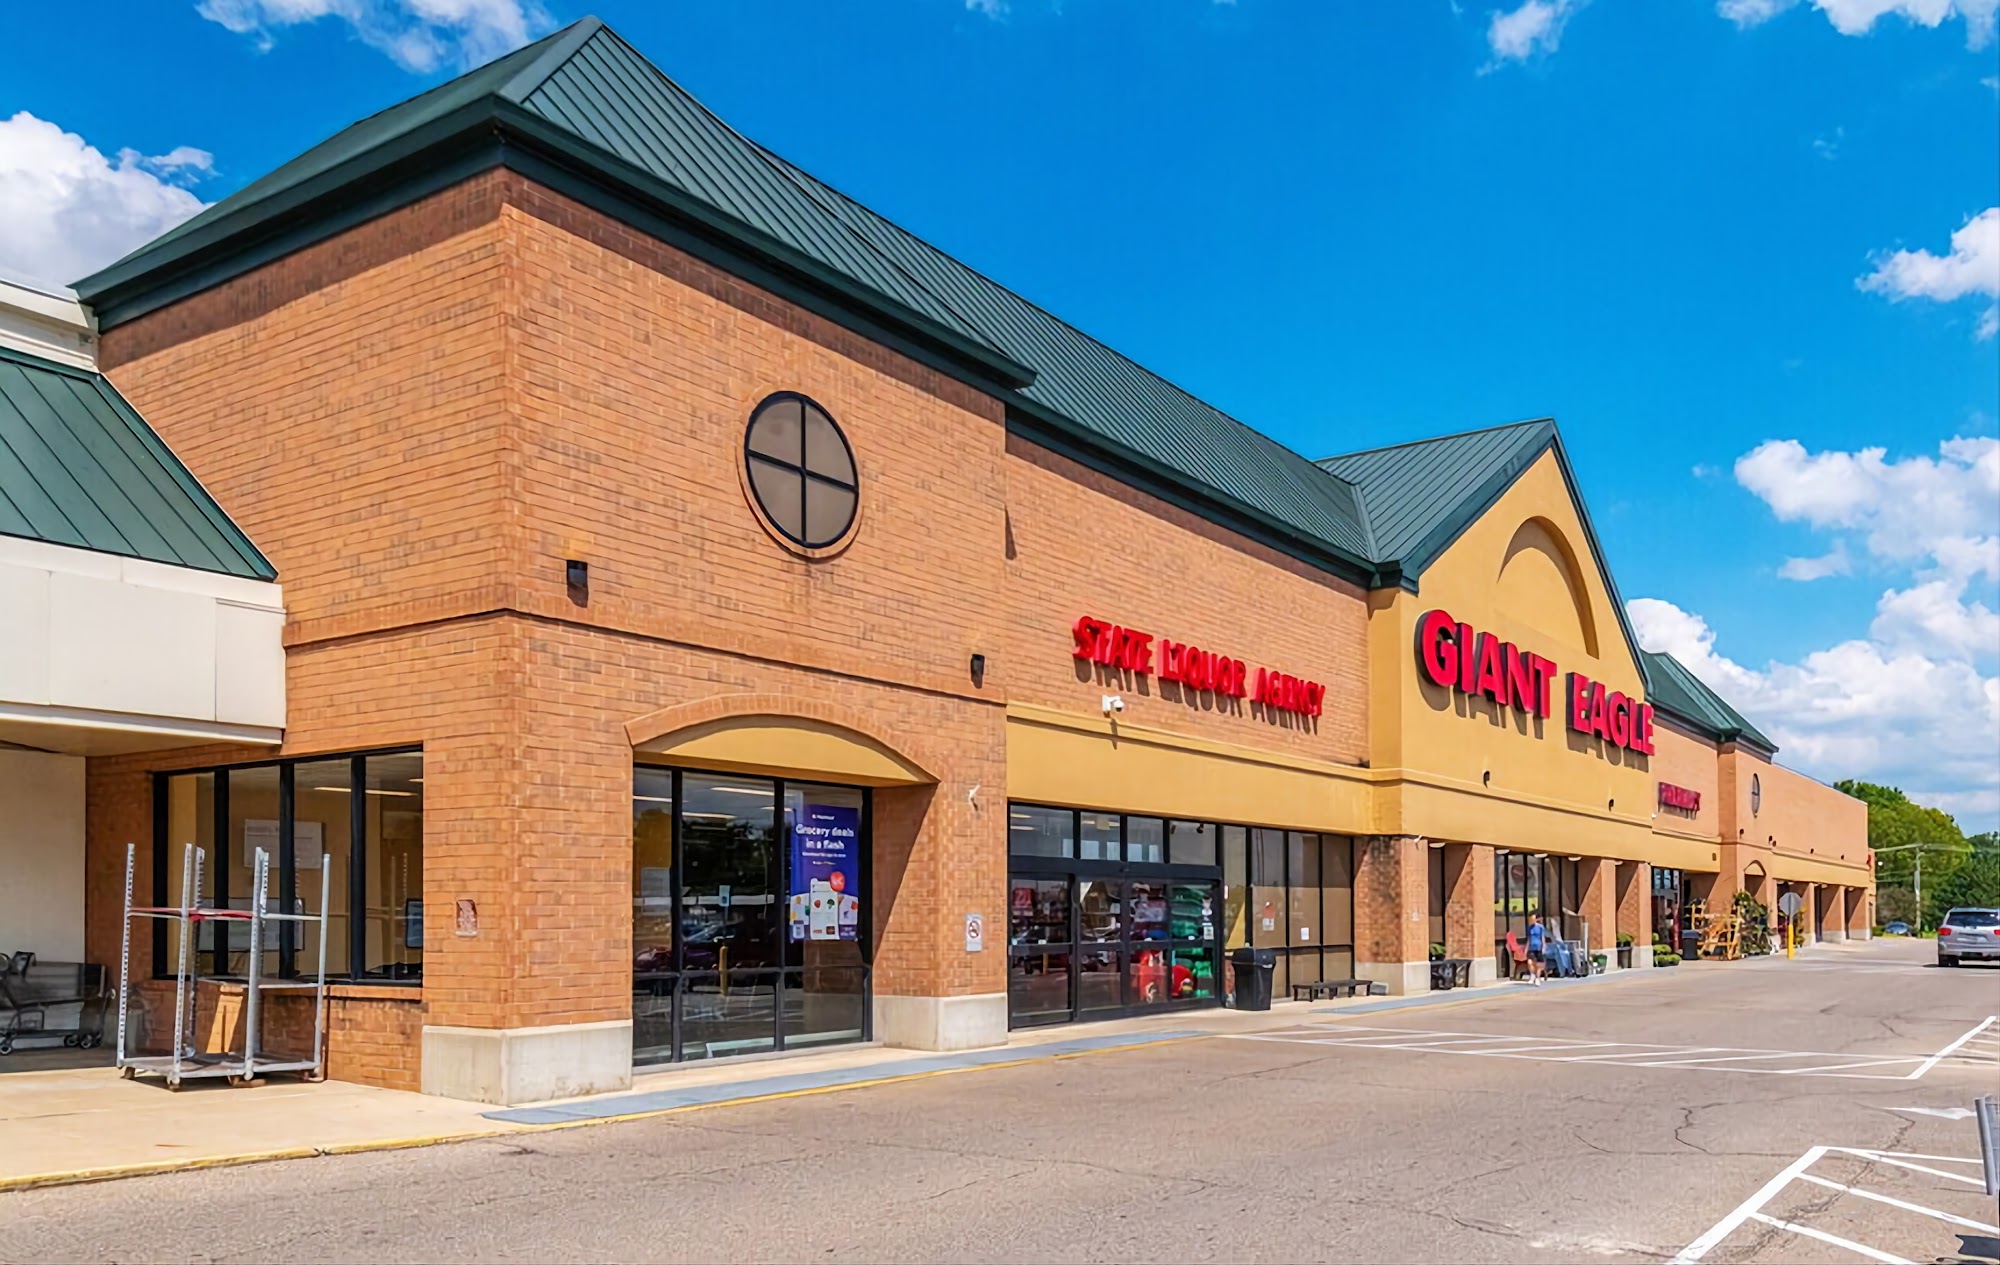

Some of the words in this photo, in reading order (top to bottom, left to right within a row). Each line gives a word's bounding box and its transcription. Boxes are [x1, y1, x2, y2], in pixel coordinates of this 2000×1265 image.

[1072, 615, 1153, 675] STATE
[1157, 639, 1247, 698] LIQUOR
[1250, 667, 1326, 717] AGENCY
[1414, 609, 1557, 719] GIANT
[1565, 672, 1655, 756] EAGLE
[795, 823, 830, 837] Grocery
[823, 839, 845, 850] flash
